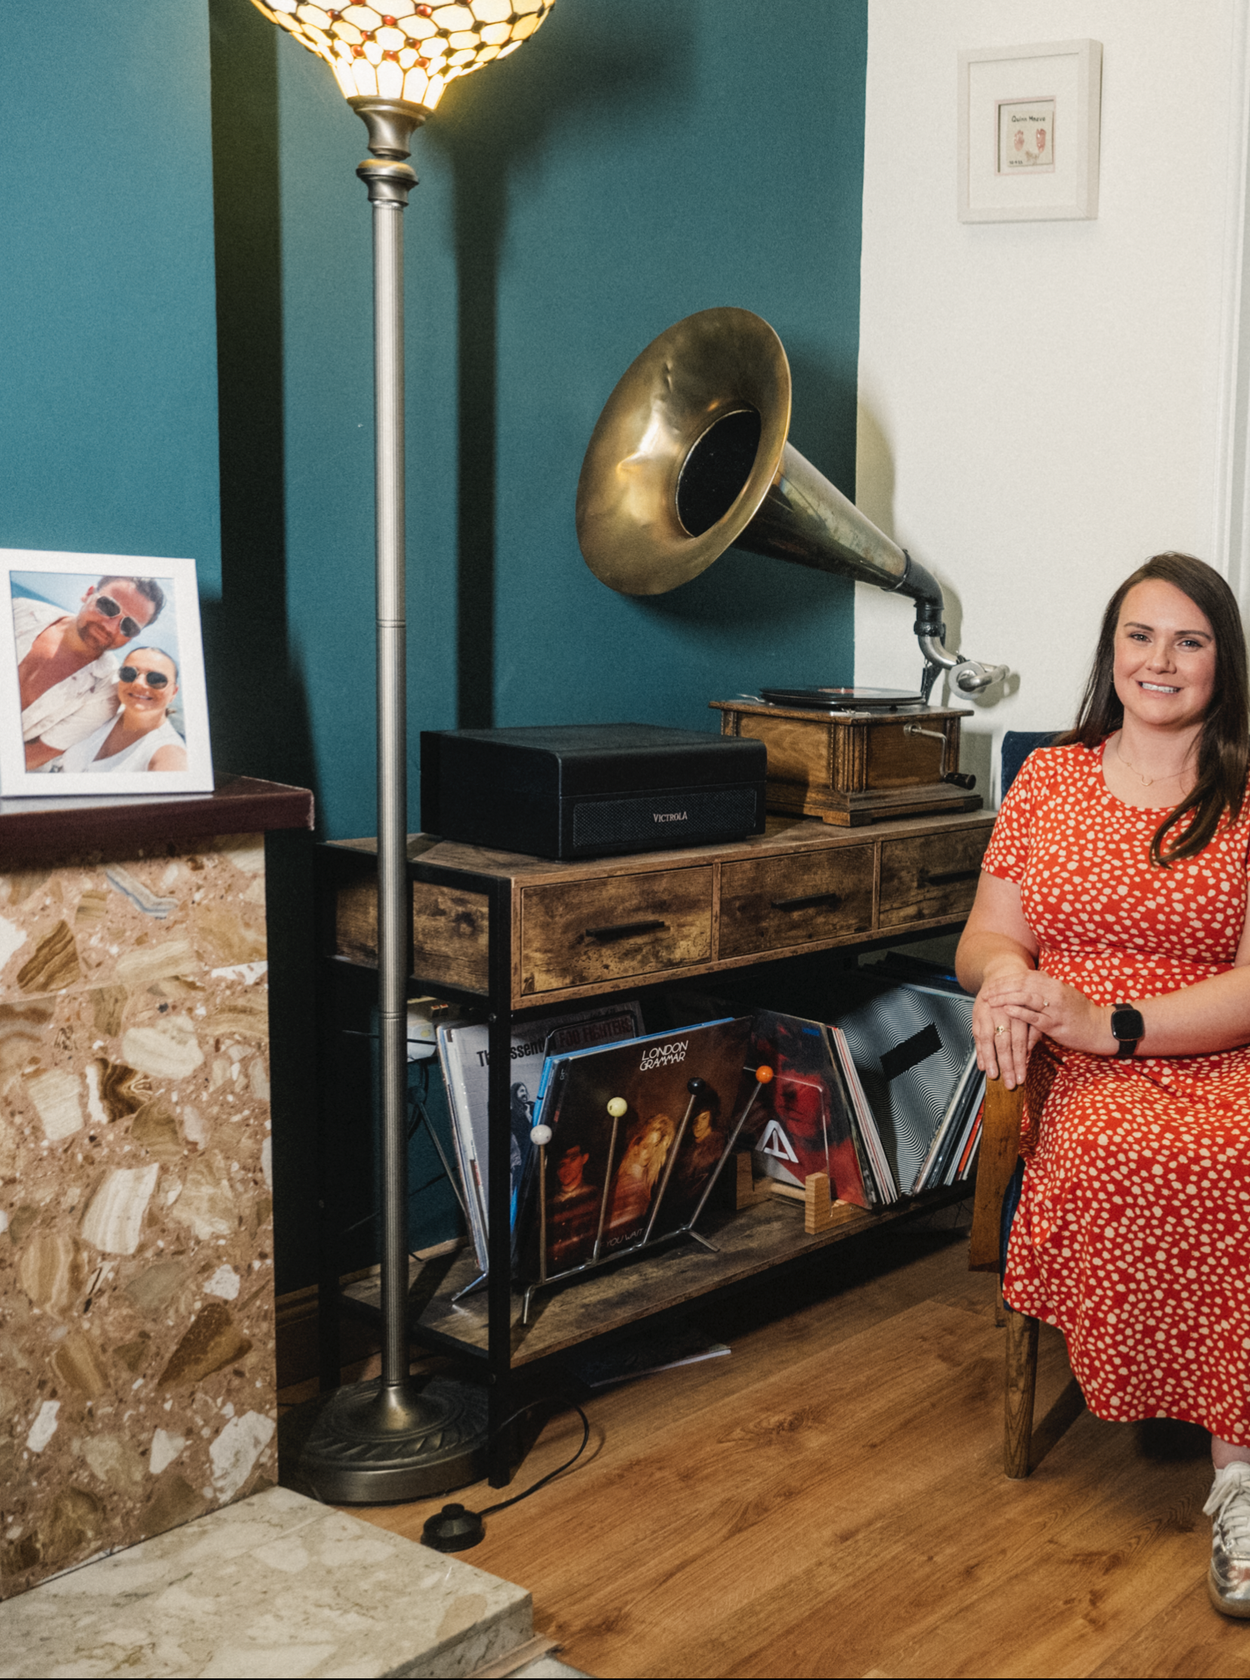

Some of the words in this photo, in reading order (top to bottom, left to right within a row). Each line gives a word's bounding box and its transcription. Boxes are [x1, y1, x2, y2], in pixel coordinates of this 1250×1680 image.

[653, 811, 688, 823] VICTROLA
[558, 1029, 581, 1048] FOO
[582, 1018, 634, 1042] FIGHTERS
[641, 1040, 689, 1061] LONDON
[639, 1051, 686, 1071] GRAMMAR
[606, 1236, 624, 1247] YOU
